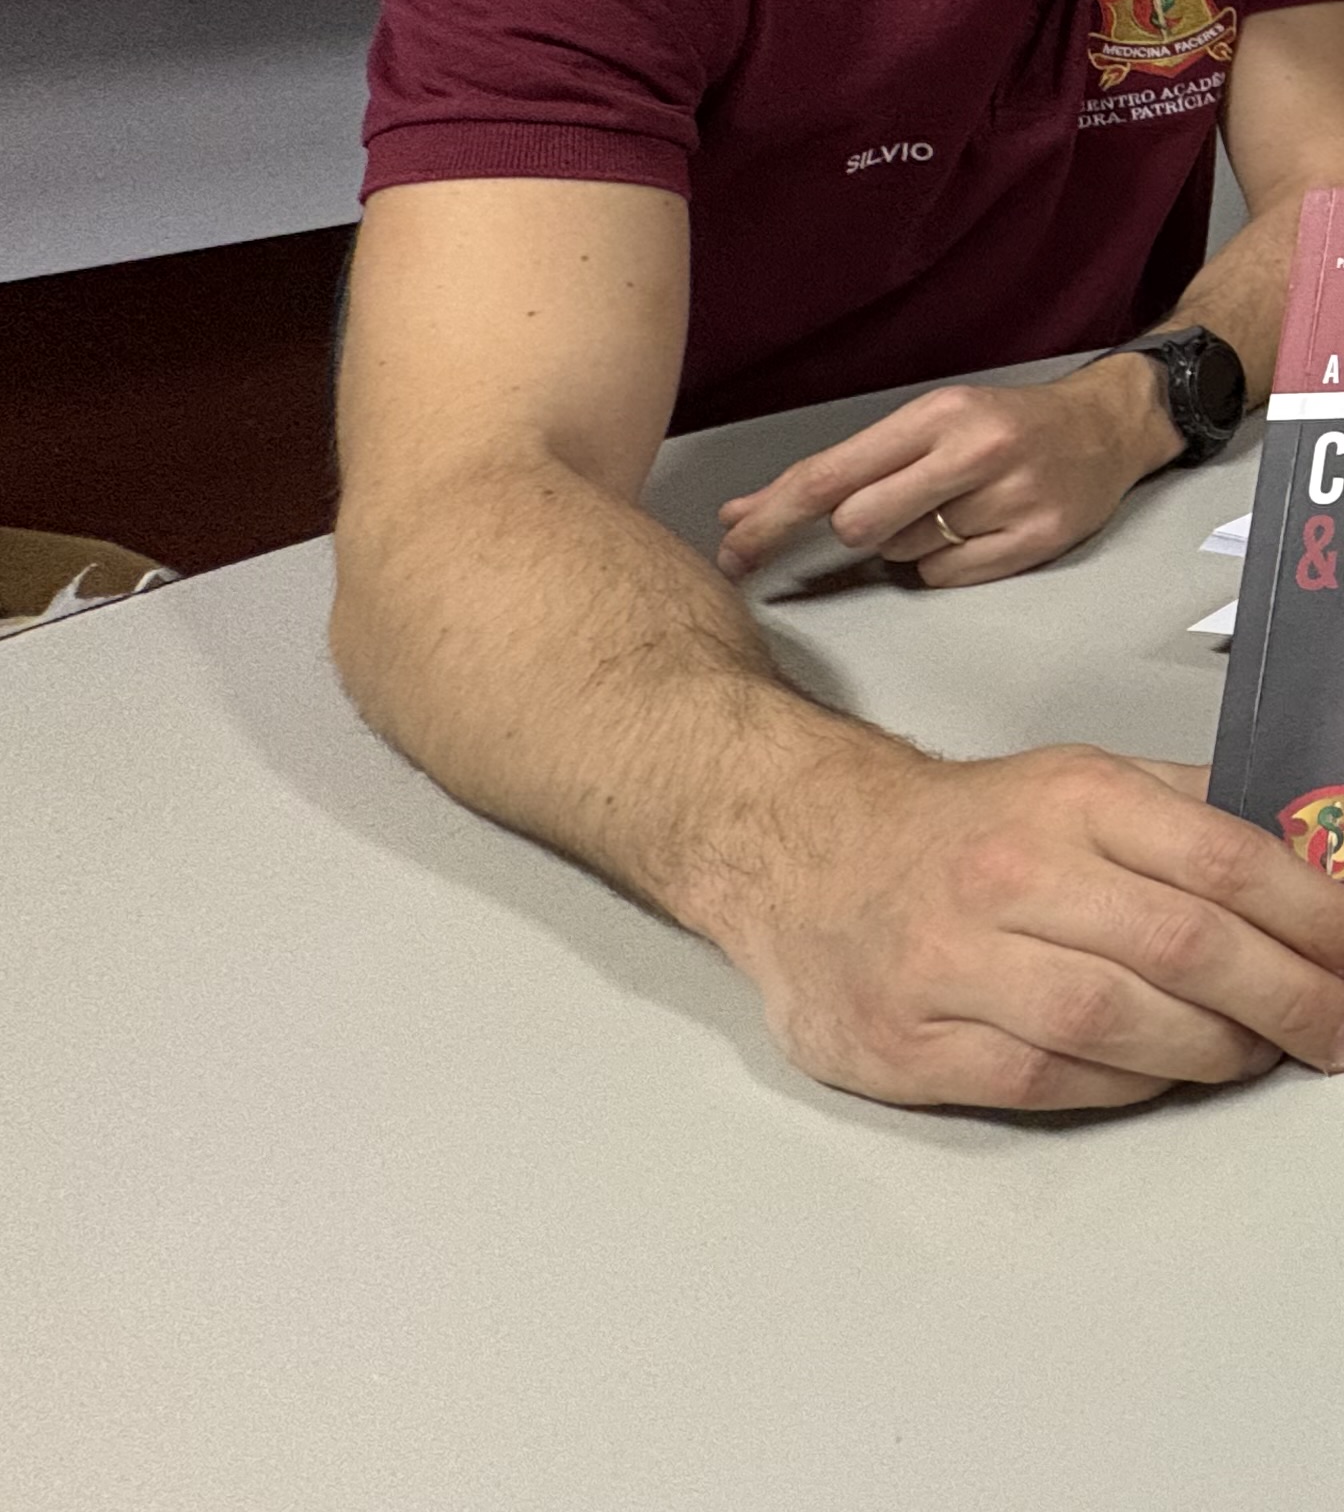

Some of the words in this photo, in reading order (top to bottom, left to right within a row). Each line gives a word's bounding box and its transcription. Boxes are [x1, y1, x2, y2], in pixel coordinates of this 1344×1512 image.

[1102, 43, 1171, 59] MEDICINA
[1173, 23, 1226, 55] FACERES
[1131, 92, 1217, 121] PATRÍCIA
[845, 141, 934, 175] SILVIO
[1323, 354, 1341, 384] A
[1295, 514, 1338, 591] &
